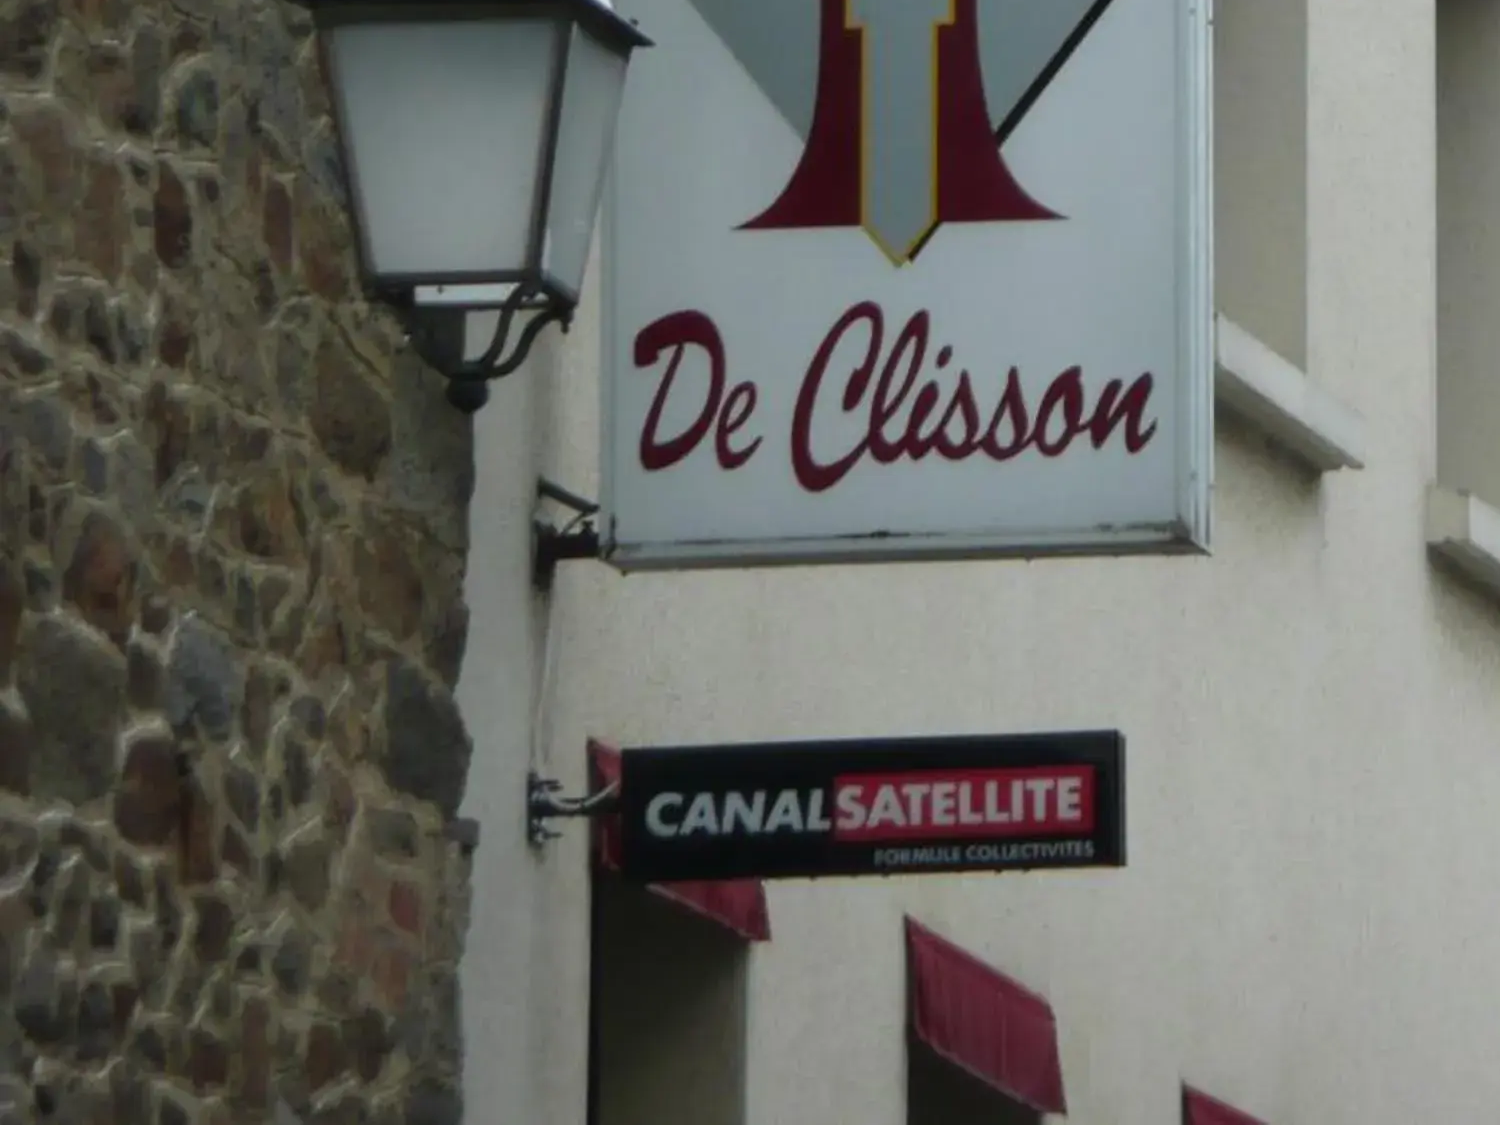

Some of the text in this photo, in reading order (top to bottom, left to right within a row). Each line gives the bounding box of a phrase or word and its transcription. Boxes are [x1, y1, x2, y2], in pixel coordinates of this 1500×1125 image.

[634, 302, 1157, 491] De Clisson
[874, 840, 1095, 866] FORMULE COLLECTIVITES
